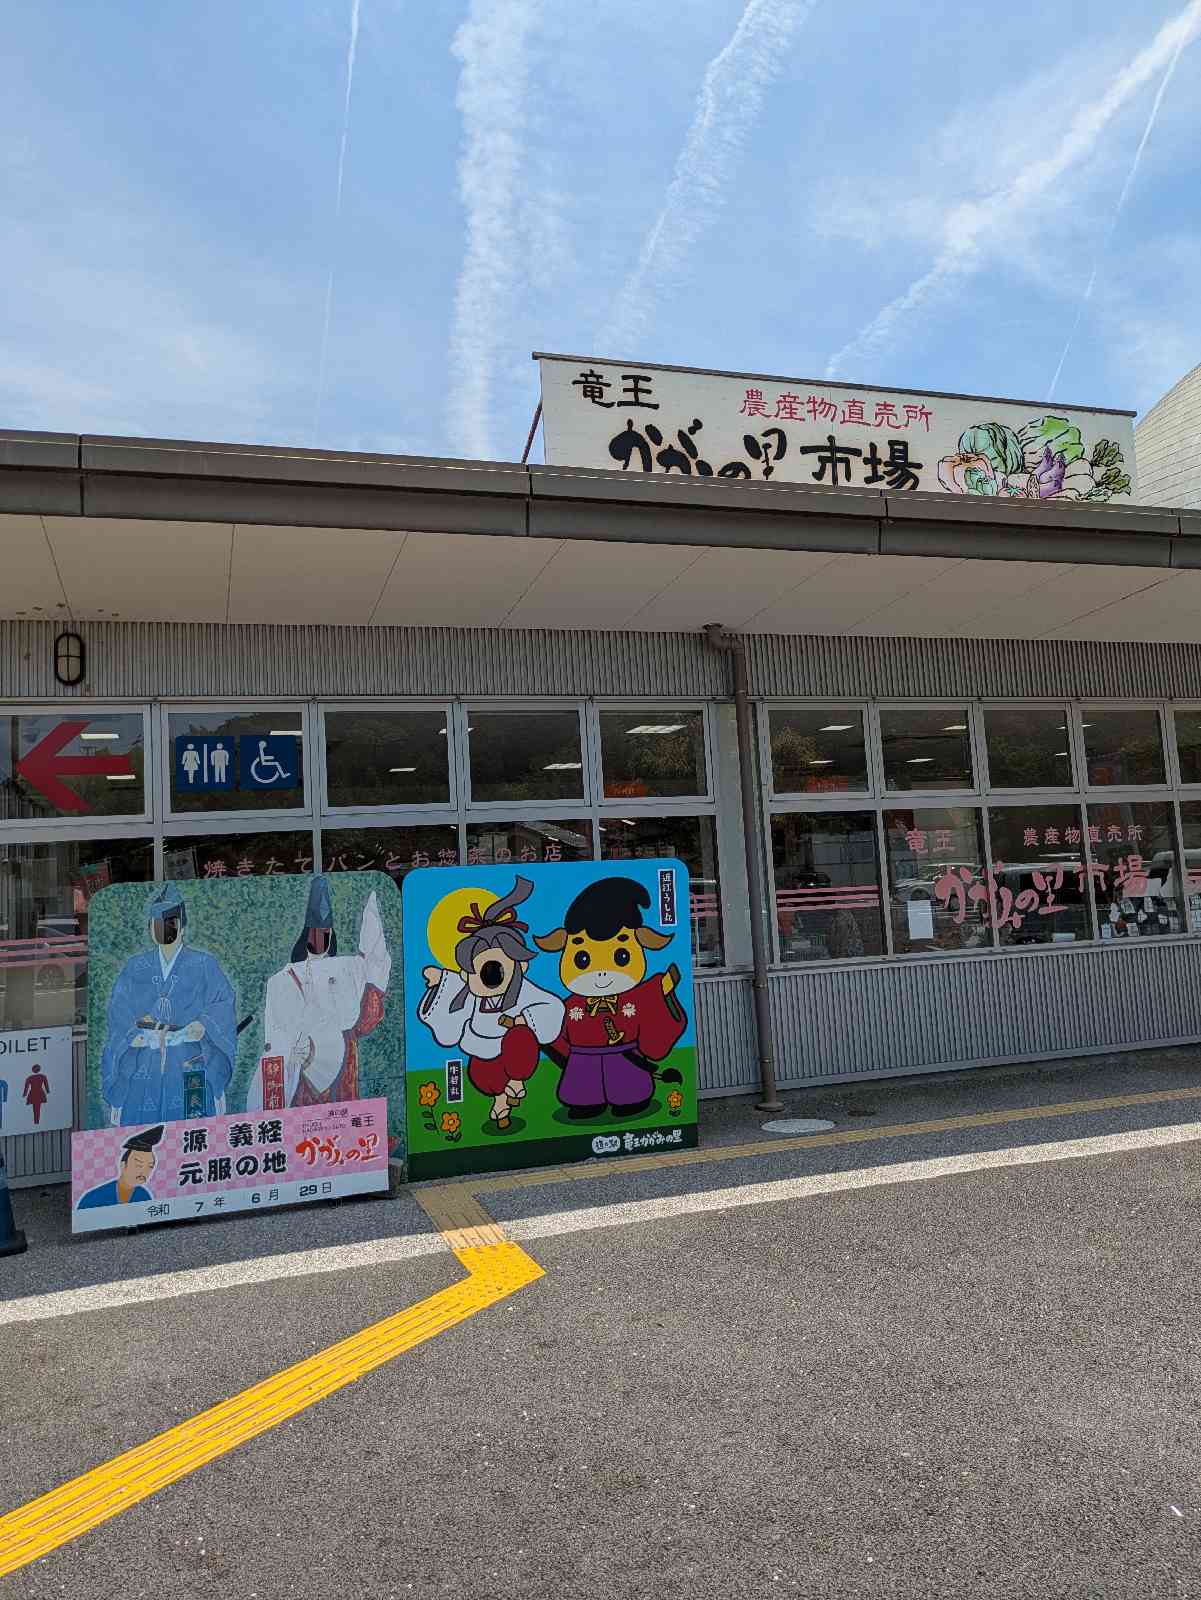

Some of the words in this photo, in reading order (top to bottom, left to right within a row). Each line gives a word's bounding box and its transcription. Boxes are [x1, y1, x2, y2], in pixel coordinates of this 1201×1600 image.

[572, 369, 660, 410] 竜王
[739, 388, 934, 432] 農産物直売所
[905, 828, 956, 854] 竜王
[1023, 824, 1145, 847] 農産物直売所
[183, 1128, 208, 1154] 源
[229, 1119, 283, 1148] 義経
[351, 1115, 375, 1128] 竜王
[295, 1132, 381, 1167] かがみの里
[178, 1151, 287, 1186] 元服の地
[147, 1203, 170, 1217] 令和
[195, 1202, 204, 1213] 7
[214, 1197, 225, 1209] 年
[251, 1192, 261, 1204] 6
[268, 1188, 279, 1201] 月
[299, 1184, 318, 1197] 29
[322, 1181, 332, 1194] 日
